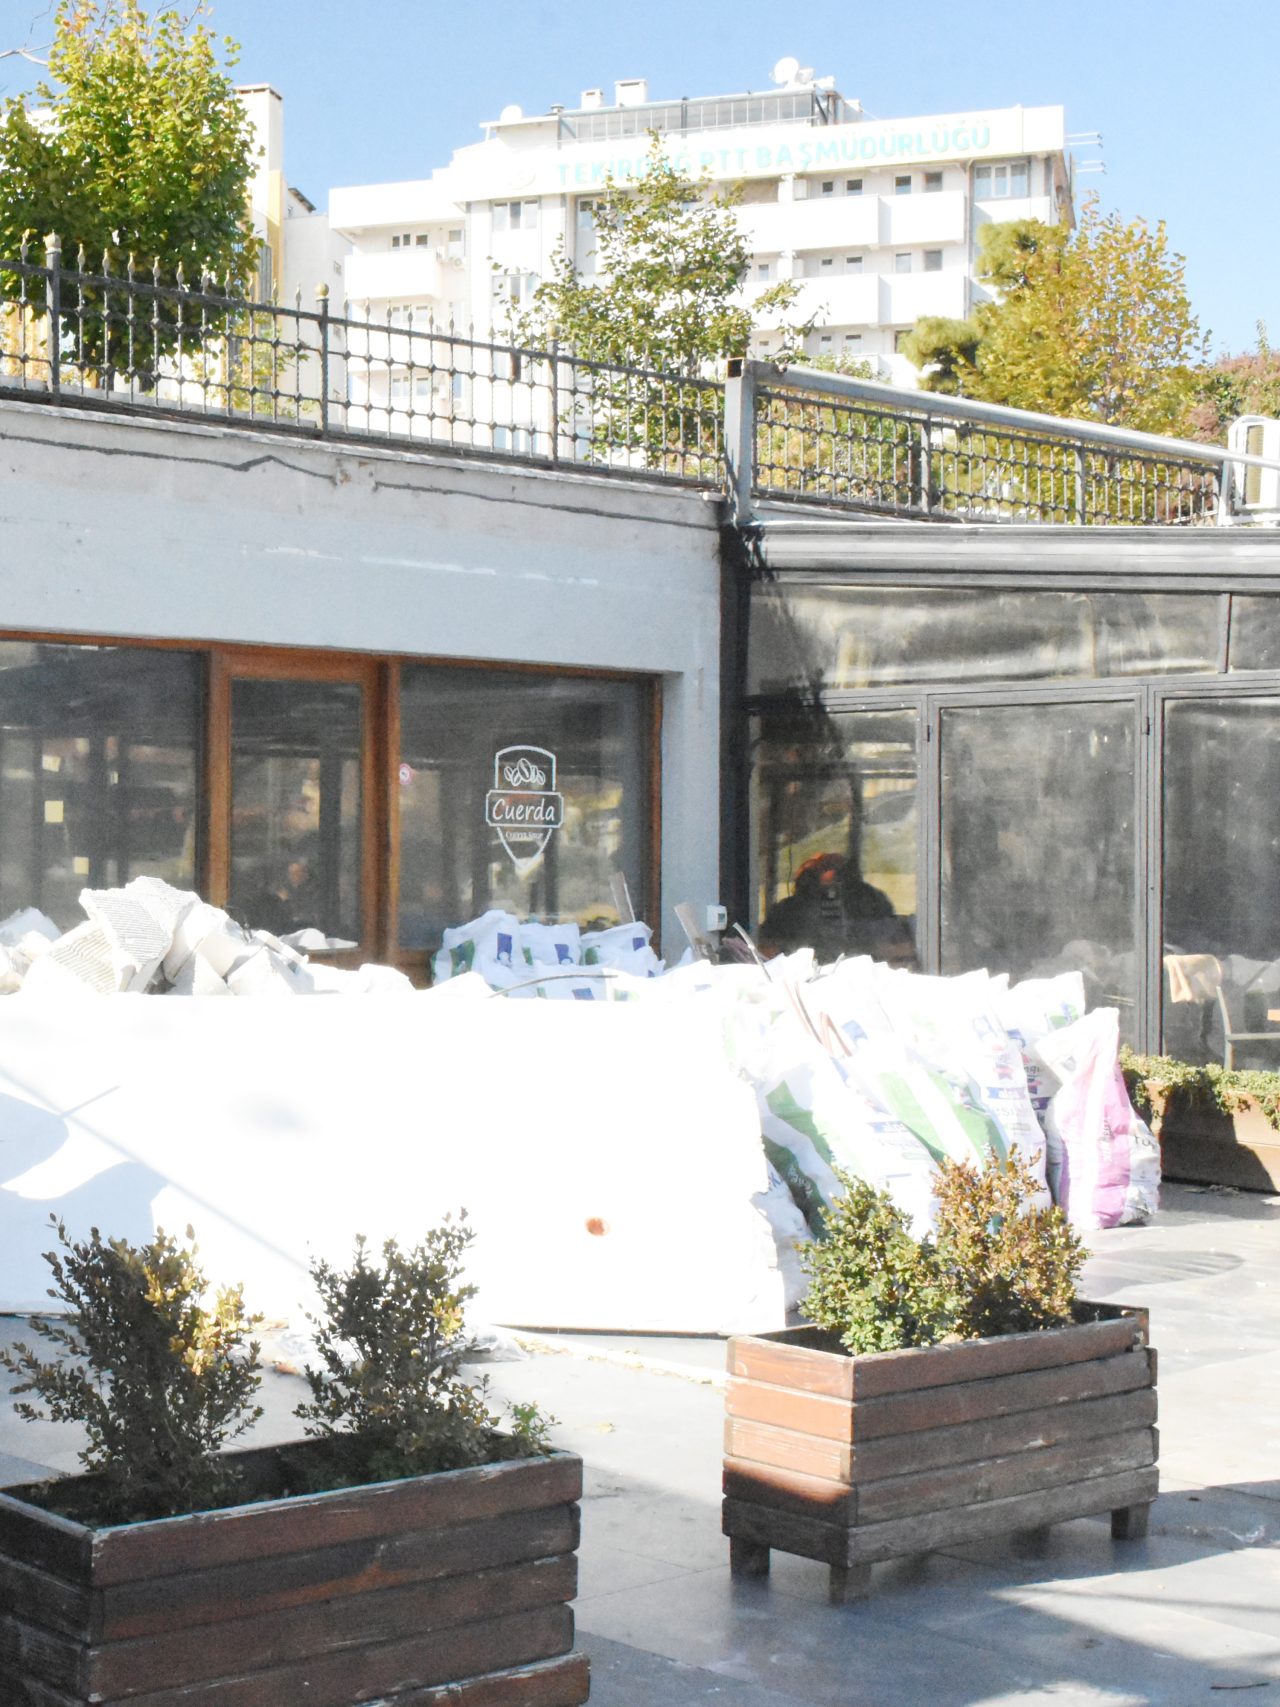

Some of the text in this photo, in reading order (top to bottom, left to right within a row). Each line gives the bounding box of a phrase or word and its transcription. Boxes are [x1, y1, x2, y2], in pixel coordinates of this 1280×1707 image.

[700, 147, 748, 172] PTT
[755, 119, 990, 172] BAŞMÜDÜRLÜĞÜ
[492, 798, 555, 821] Cuerda
